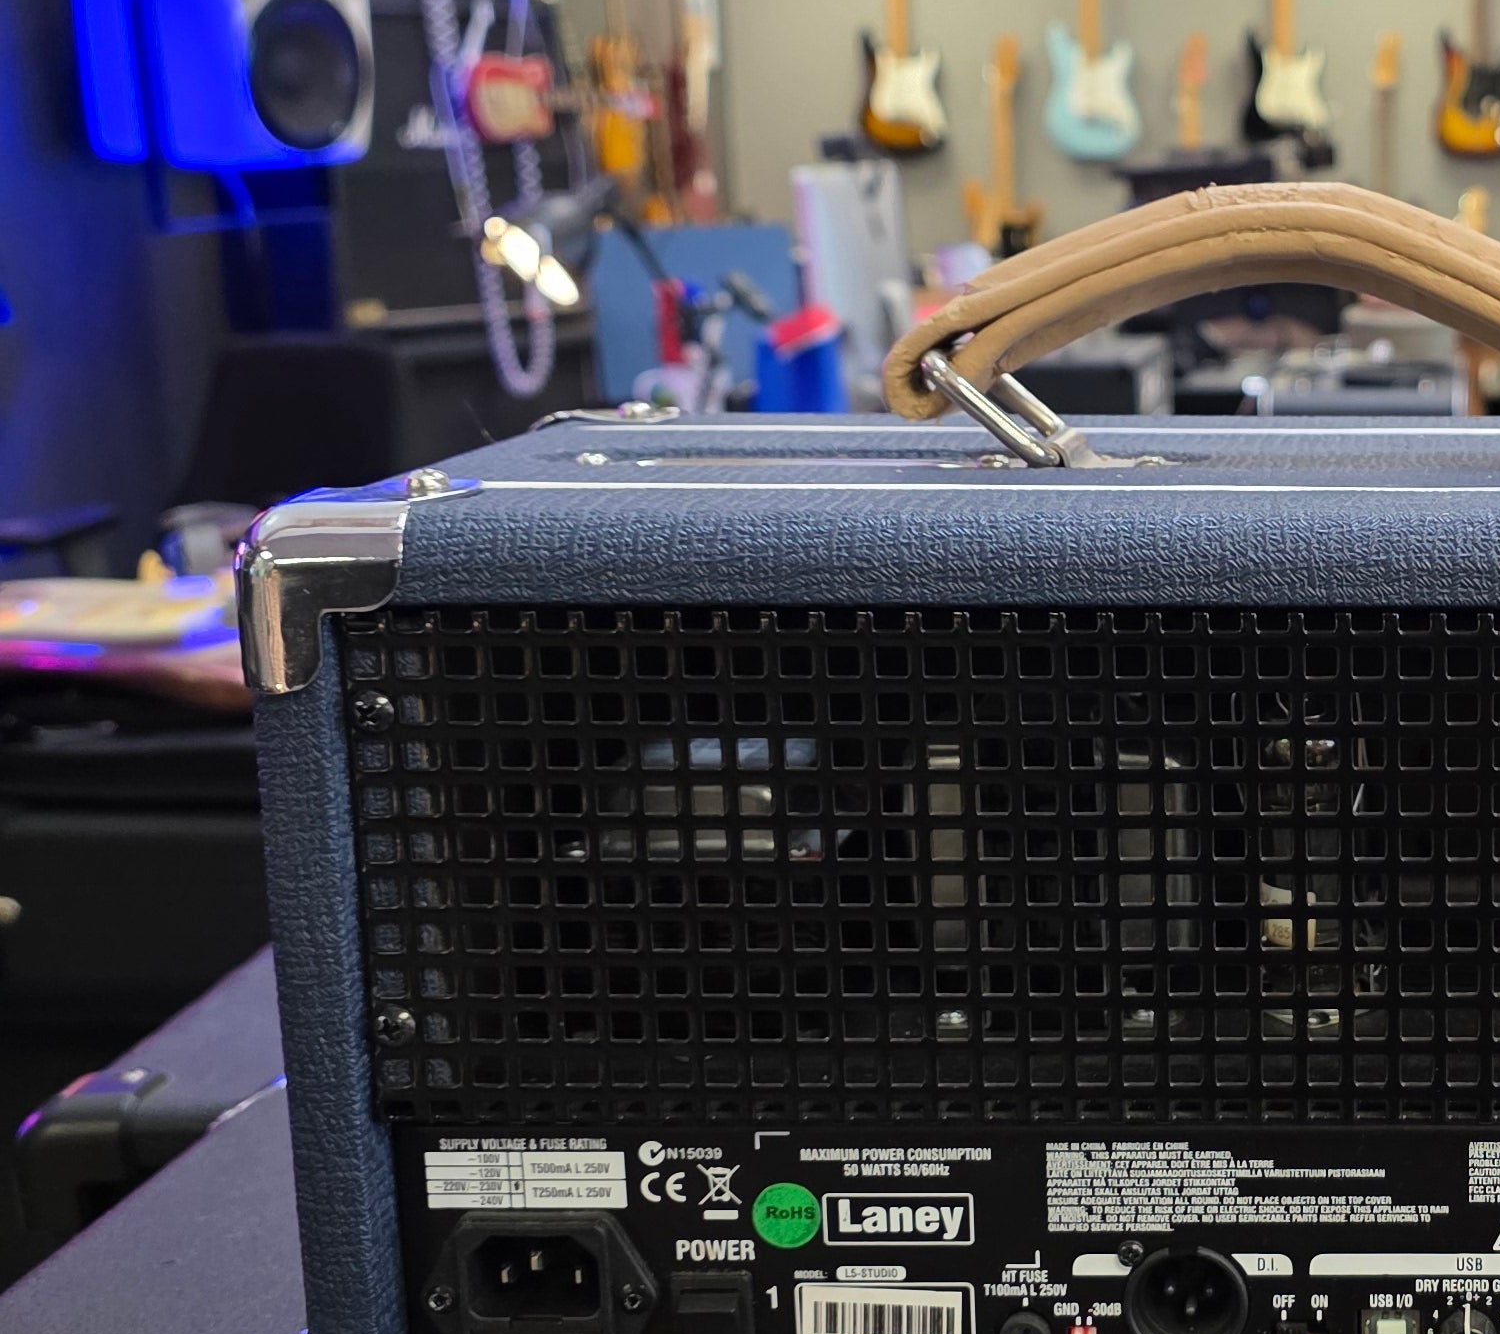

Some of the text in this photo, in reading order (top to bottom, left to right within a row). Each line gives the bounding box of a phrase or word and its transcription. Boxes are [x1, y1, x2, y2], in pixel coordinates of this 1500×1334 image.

[439, 1138, 607, 1150] SUPPLY VOLTAGE & FUSE RATING
[666, 1147, 722, 1160] N15039
[800, 1148, 992, 1161] MAXIMUM POWER CONSUMPTION
[530, 1163, 610, 1174] T500mA L 250V
[843, 1164, 950, 1176] 50 WATTS 50/60Hz
[532, 1187, 612, 1198] T250mA L 250V
[766, 1206, 815, 1219] RoHS
[838, 1198, 964, 1241] Laney
[675, 1240, 755, 1261] POWER
[1257, 1258, 1279, 1271] D.I.
[1456, 1258, 1483, 1271] USB
[844, 1268, 898, 1279] L5-STUDIO
[1001, 1270, 1048, 1283] HT FUSE
[984, 1284, 1067, 1296] T100mA L 250V
[1415, 1279, 1439, 1293] DRY
[1442, 1279, 1490, 1293] RECORD
[765, 1285, 778, 1309] 1
[1272, 1295, 1295, 1308] OFF
[1311, 1295, 1328, 1308] ON
[1370, 1294, 1413, 1308] USB I/O
[1054, 1303, 1079, 1316] GND
[1088, 1303, 1122, 1316] -30dB
